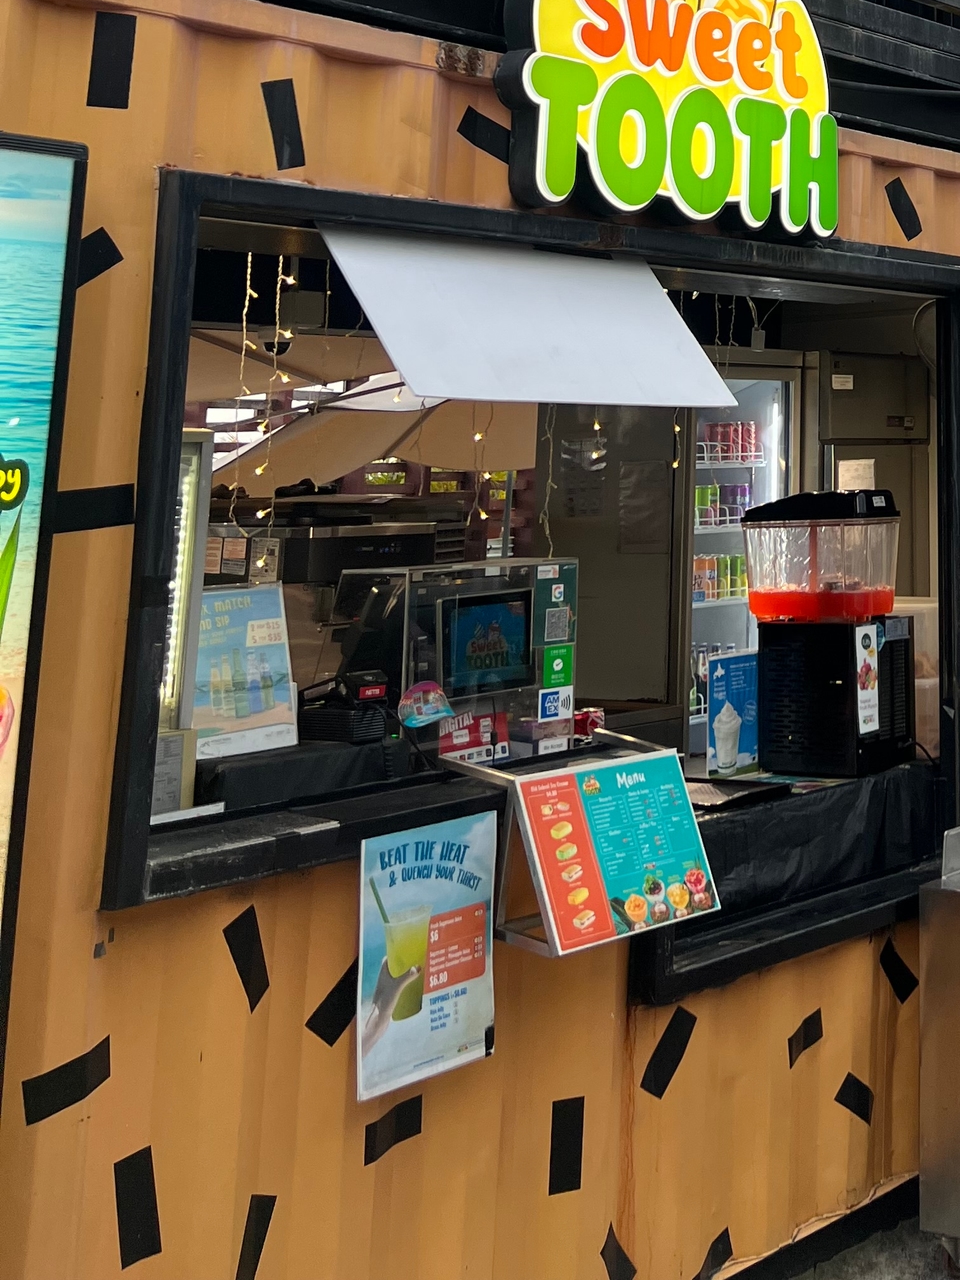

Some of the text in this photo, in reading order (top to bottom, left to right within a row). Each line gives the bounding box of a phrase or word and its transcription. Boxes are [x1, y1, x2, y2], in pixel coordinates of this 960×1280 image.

[525, 53, 840, 237] TOOTH
[615, 771, 646, 789] Menu
[379, 839, 470, 871] BEAT THE HEAT
[389, 864, 482, 891] & QUENCH YOUR THIRST
[430, 930, 439, 944] $6
[429, 970, 448, 989] $6.80
